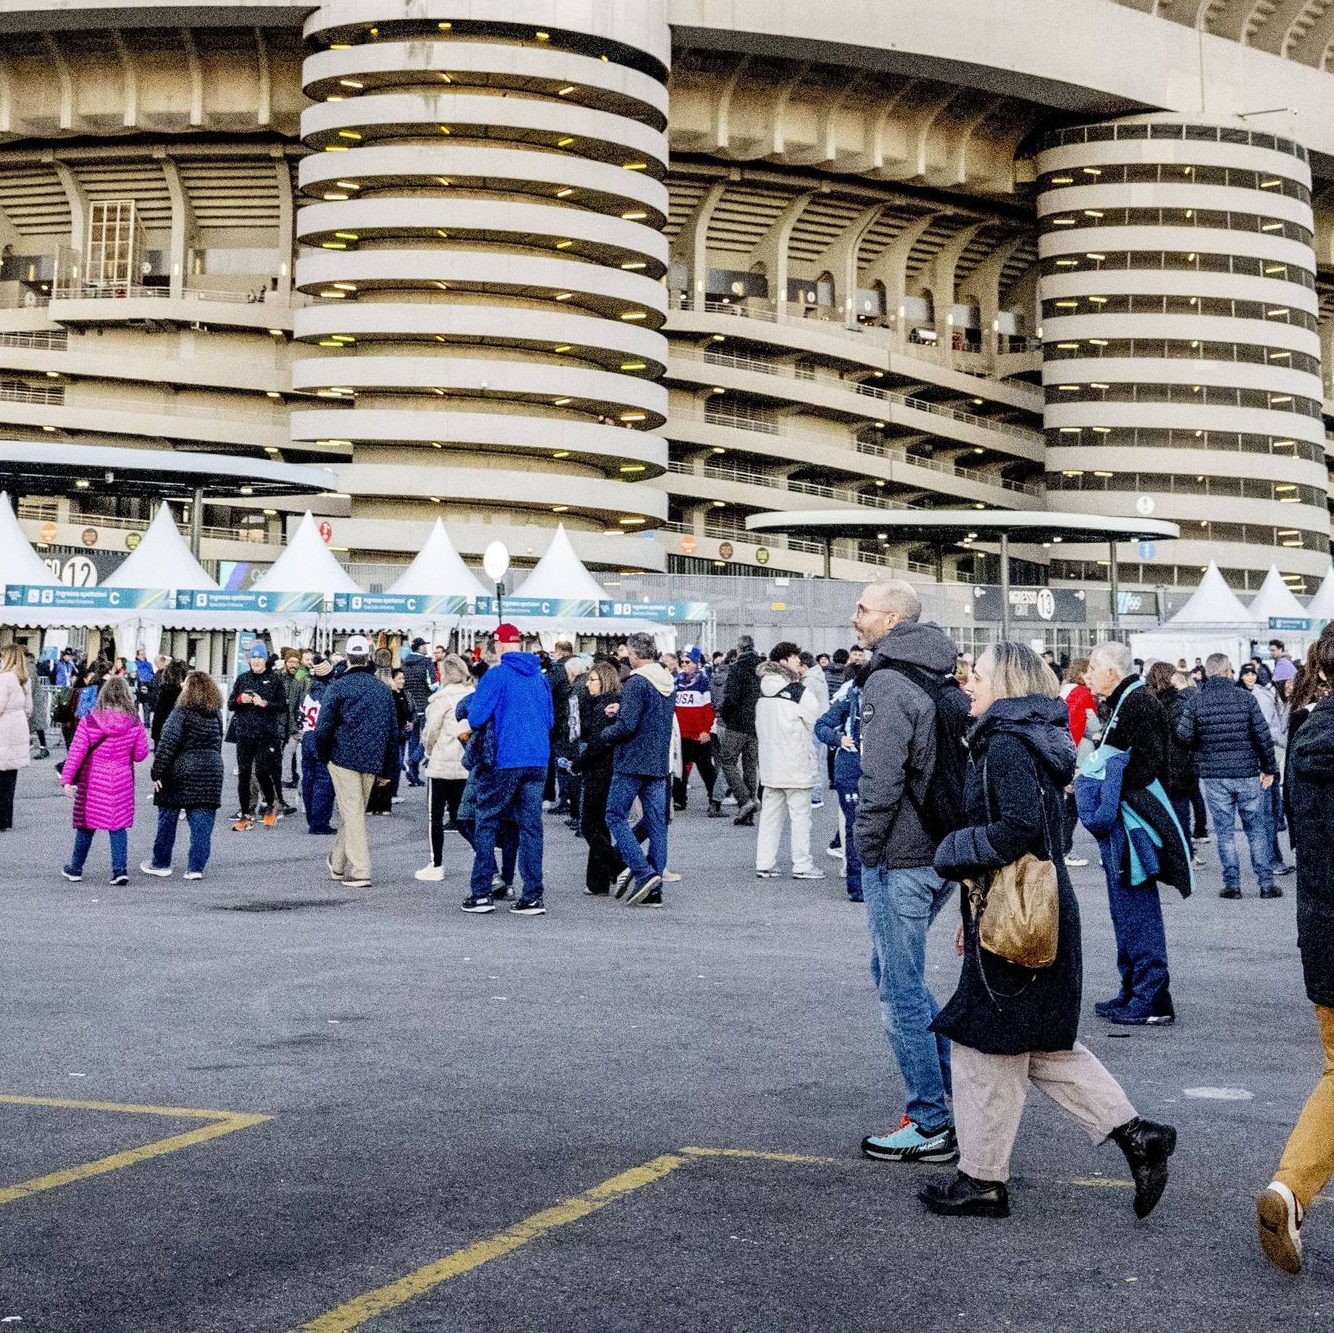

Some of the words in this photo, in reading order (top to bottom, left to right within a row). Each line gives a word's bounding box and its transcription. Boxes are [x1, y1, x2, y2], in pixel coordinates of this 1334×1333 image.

[68, 562, 91, 587] 12
[109, 592, 120, 605] C
[257, 595, 267, 608] C
[407, 598, 416, 610] C
[1040, 593, 1052, 615] 13
[542, 602, 550, 613] C
[668, 606, 675, 616] C
[676, 693, 694, 705] USA
